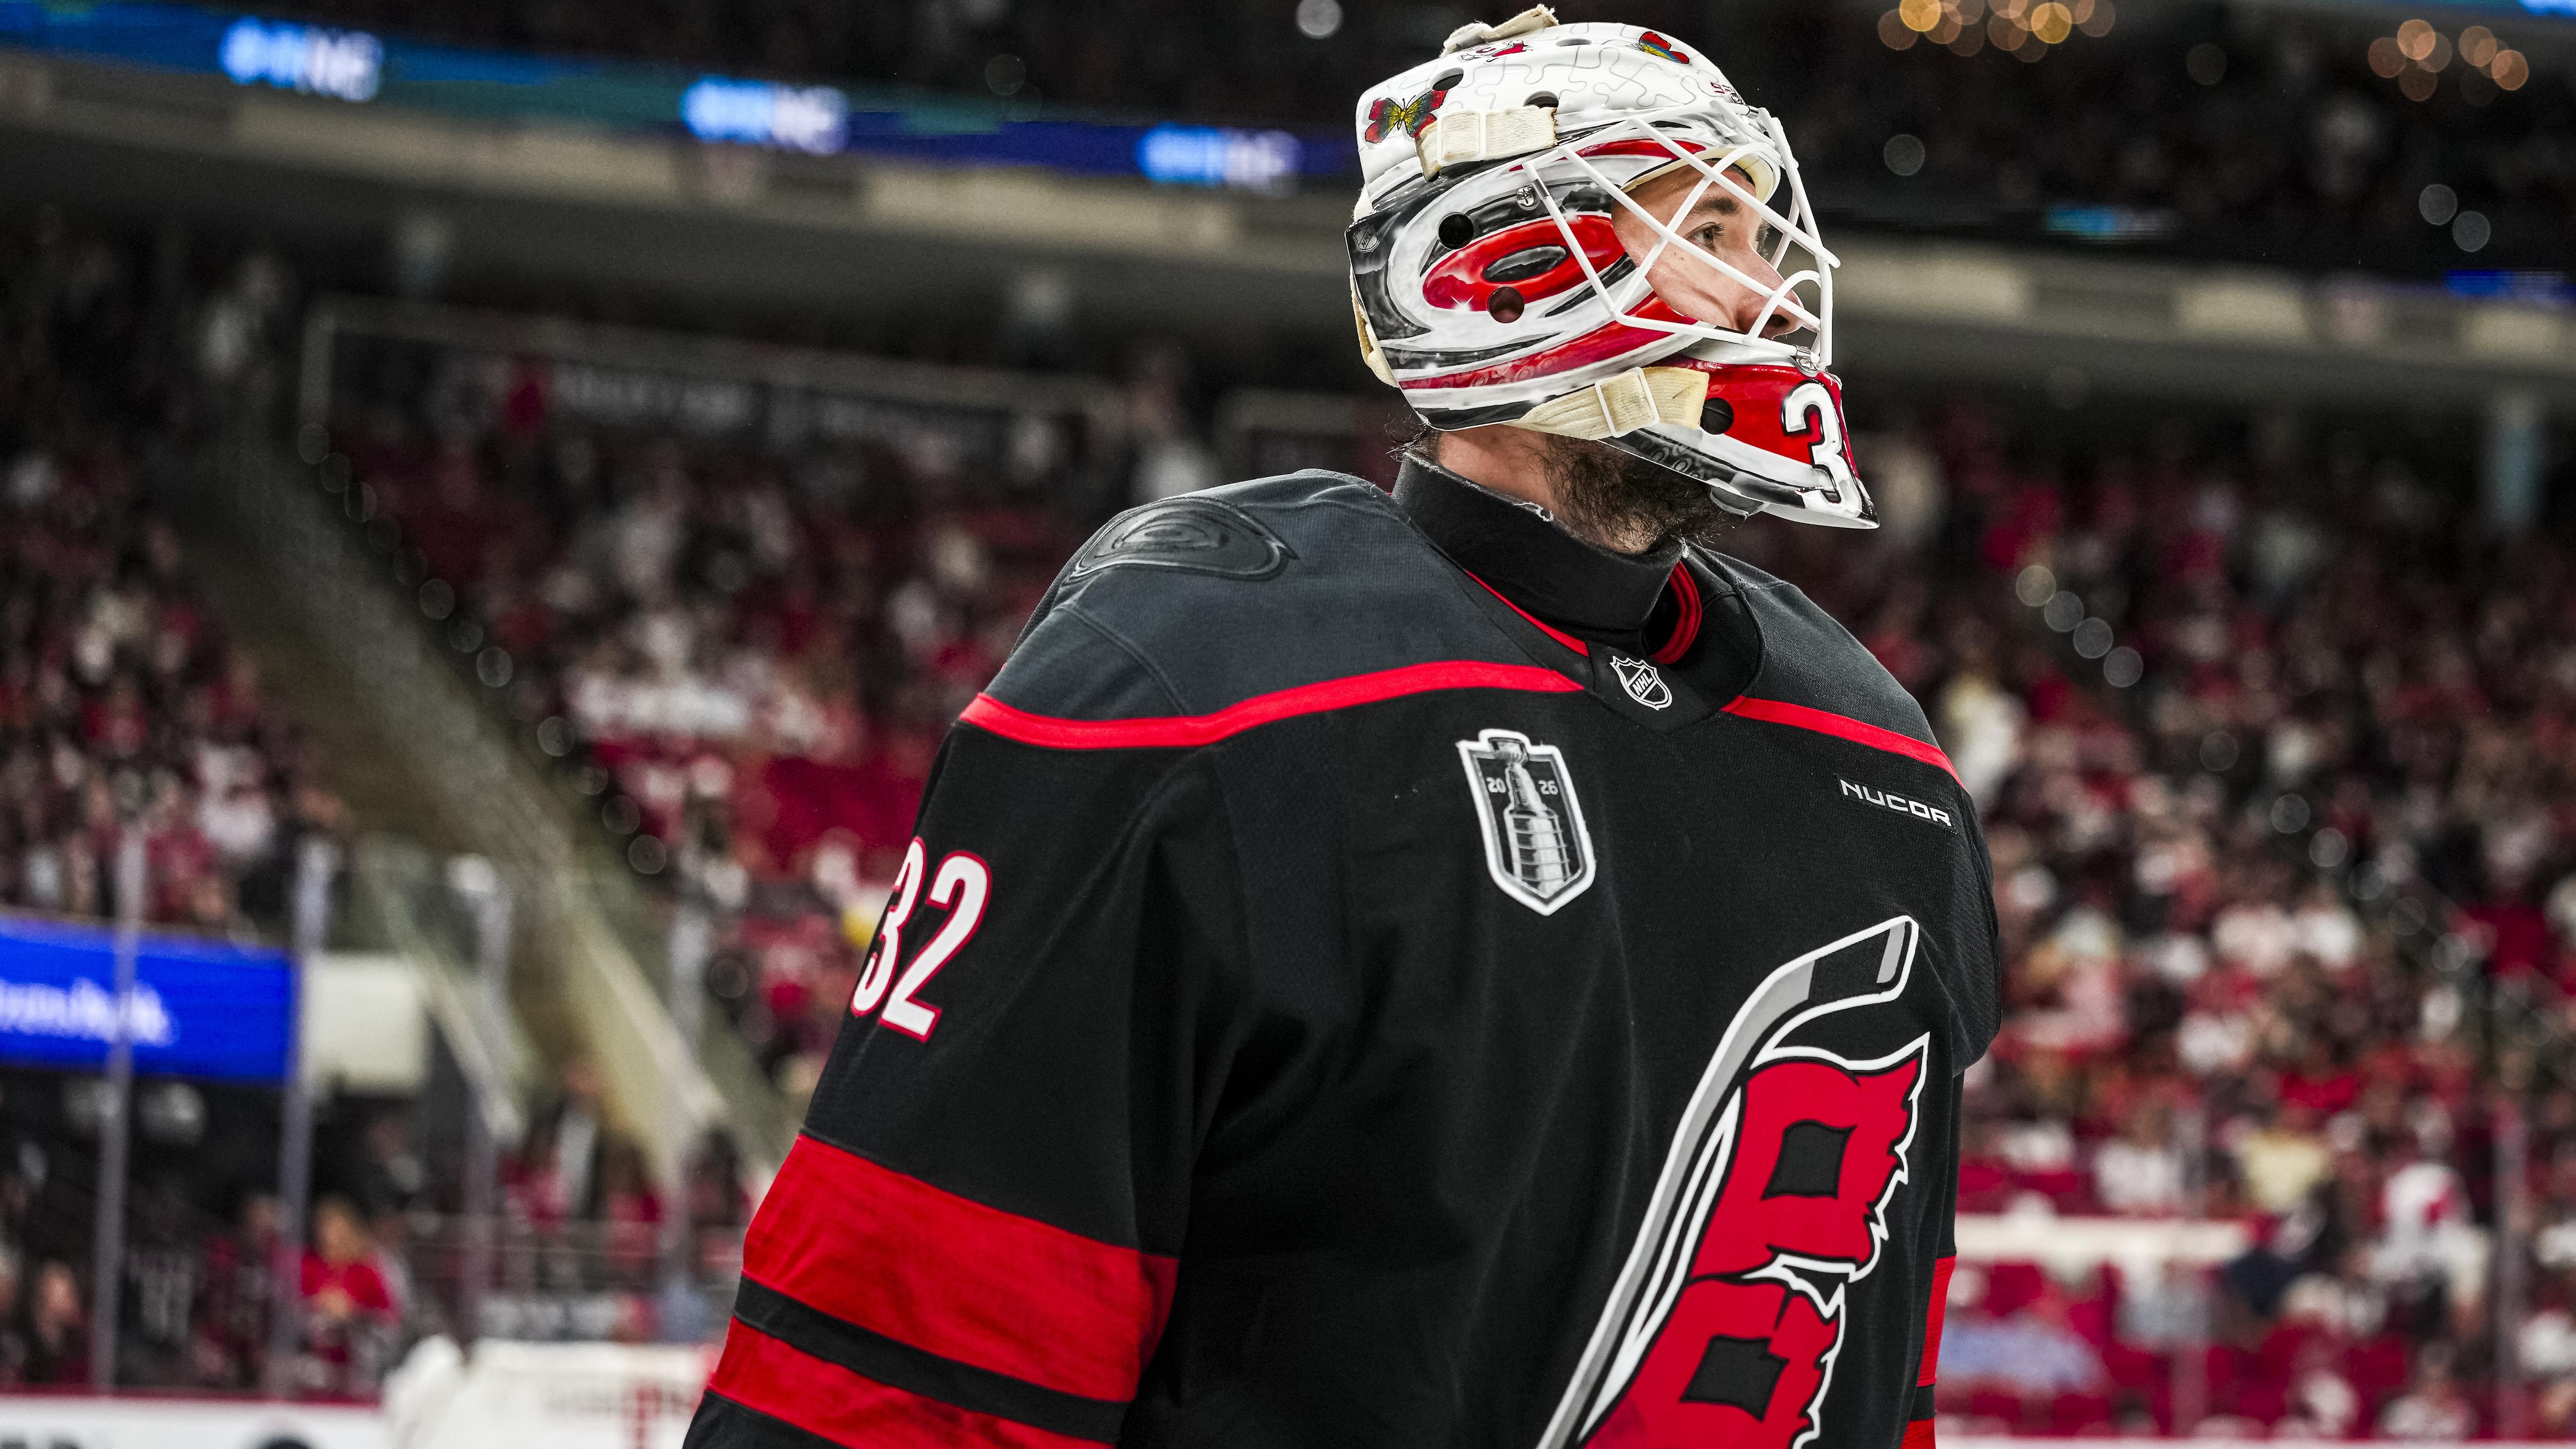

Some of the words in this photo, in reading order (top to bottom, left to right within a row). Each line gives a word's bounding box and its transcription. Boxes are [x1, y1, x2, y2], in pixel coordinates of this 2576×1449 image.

[1632, 672, 1653, 696] NHL
[1486, 777, 1506, 793] 20
[1538, 780, 1558, 795] 26
[1840, 779, 1952, 827] NUCOR
[851, 836, 992, 1043] 32
